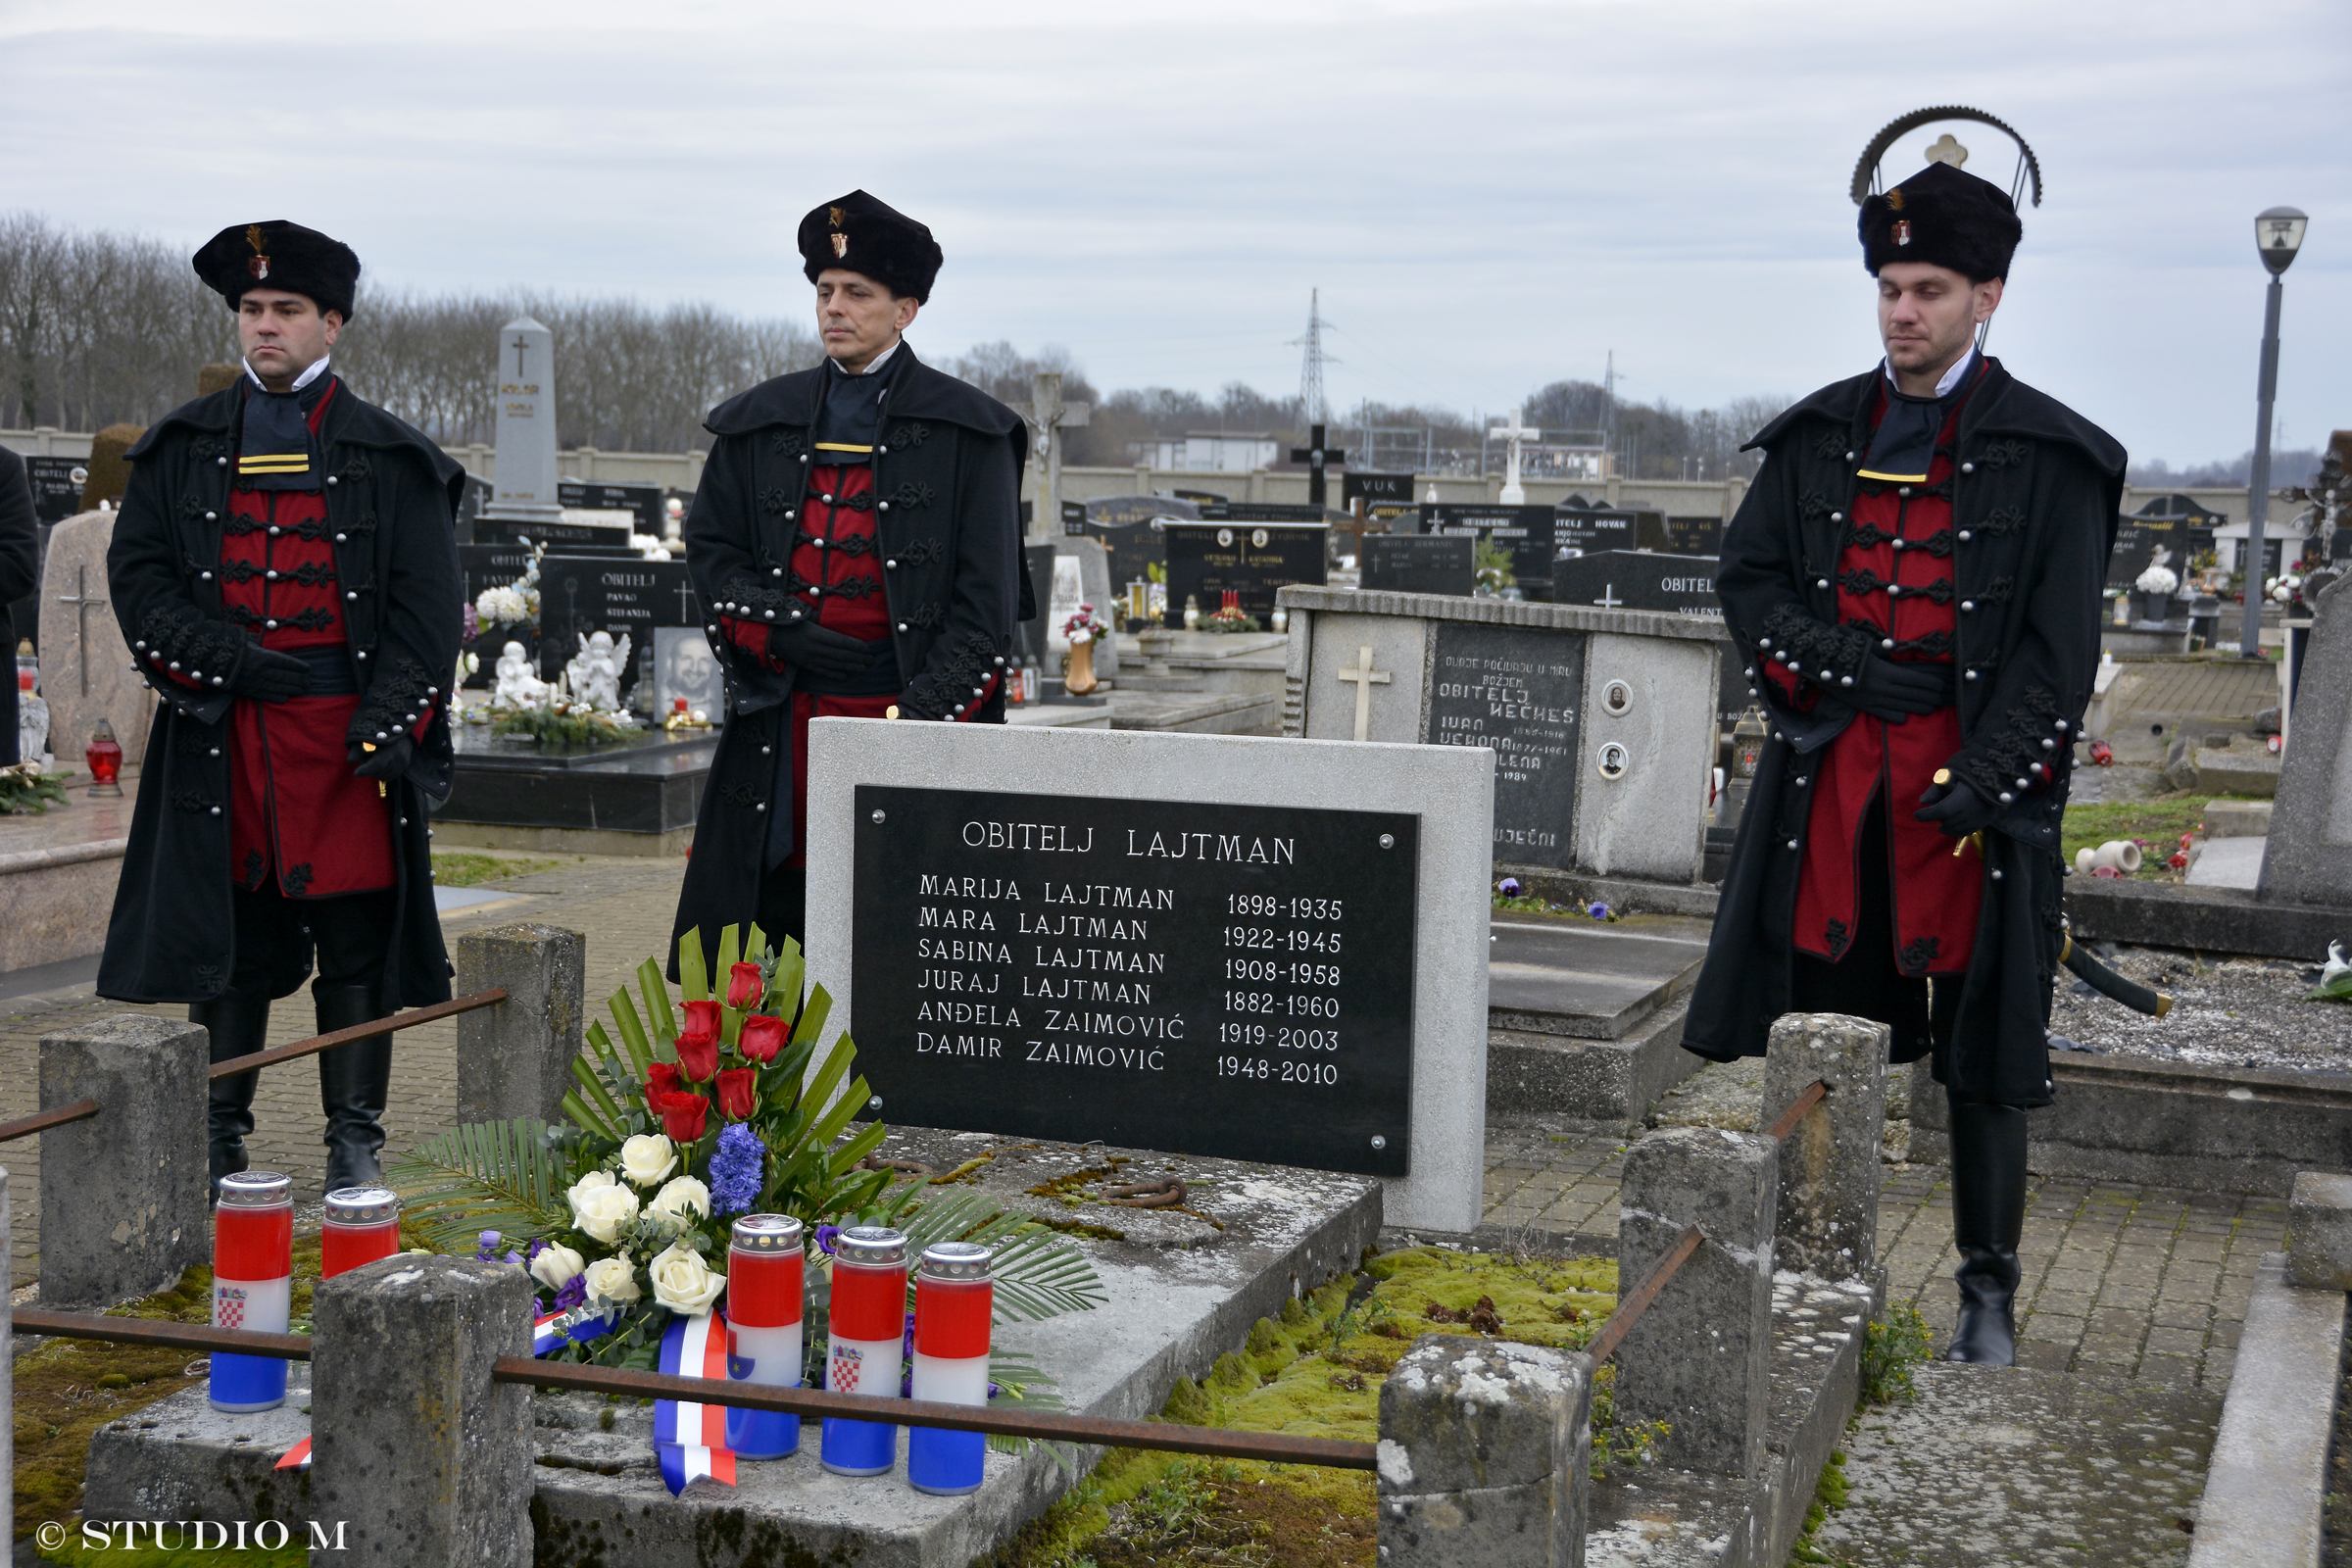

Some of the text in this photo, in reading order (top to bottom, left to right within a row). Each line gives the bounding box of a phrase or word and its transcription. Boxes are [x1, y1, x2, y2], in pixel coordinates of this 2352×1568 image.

[1362, 480, 1396, 492] VUK
[1555, 518, 1627, 529] ITELJ NOVAK
[491, 555, 527, 566] OBITEL
[601, 572, 656, 588] OBITELJ
[1661, 577, 1715, 593] OBITEL
[607, 592, 638, 602] PAVAO
[1679, 607, 1723, 616] VALENT
[1538, 664, 1545, 674] U
[1482, 673, 1524, 688] BOŽJEM
[1439, 683, 1530, 704] OBITELJ
[1727, 710, 1743, 721] BOŽ
[1495, 754, 1541, 770] LENA
[1503, 771, 1527, 781] 1989
[962, 821, 1295, 865] OBITELJ LAJTMAN
[919, 874, 1343, 920] MARIJA LAJTMAN 1898-1935
[918, 906, 1342, 954] MARA LAJTMAN 1922-1945
[918, 938, 1341, 987] SABINA LAJTMAN 1908-1958
[917, 969, 1340, 1018] JURAJ LAJTMAN 1882-1960
[917, 1001, 1339, 1052] ANĐELA ZAIMOVIĆ 1919-2003
[916, 1032, 1338, 1085] DAMIR ZAIMOVIĆ 1948-2010
